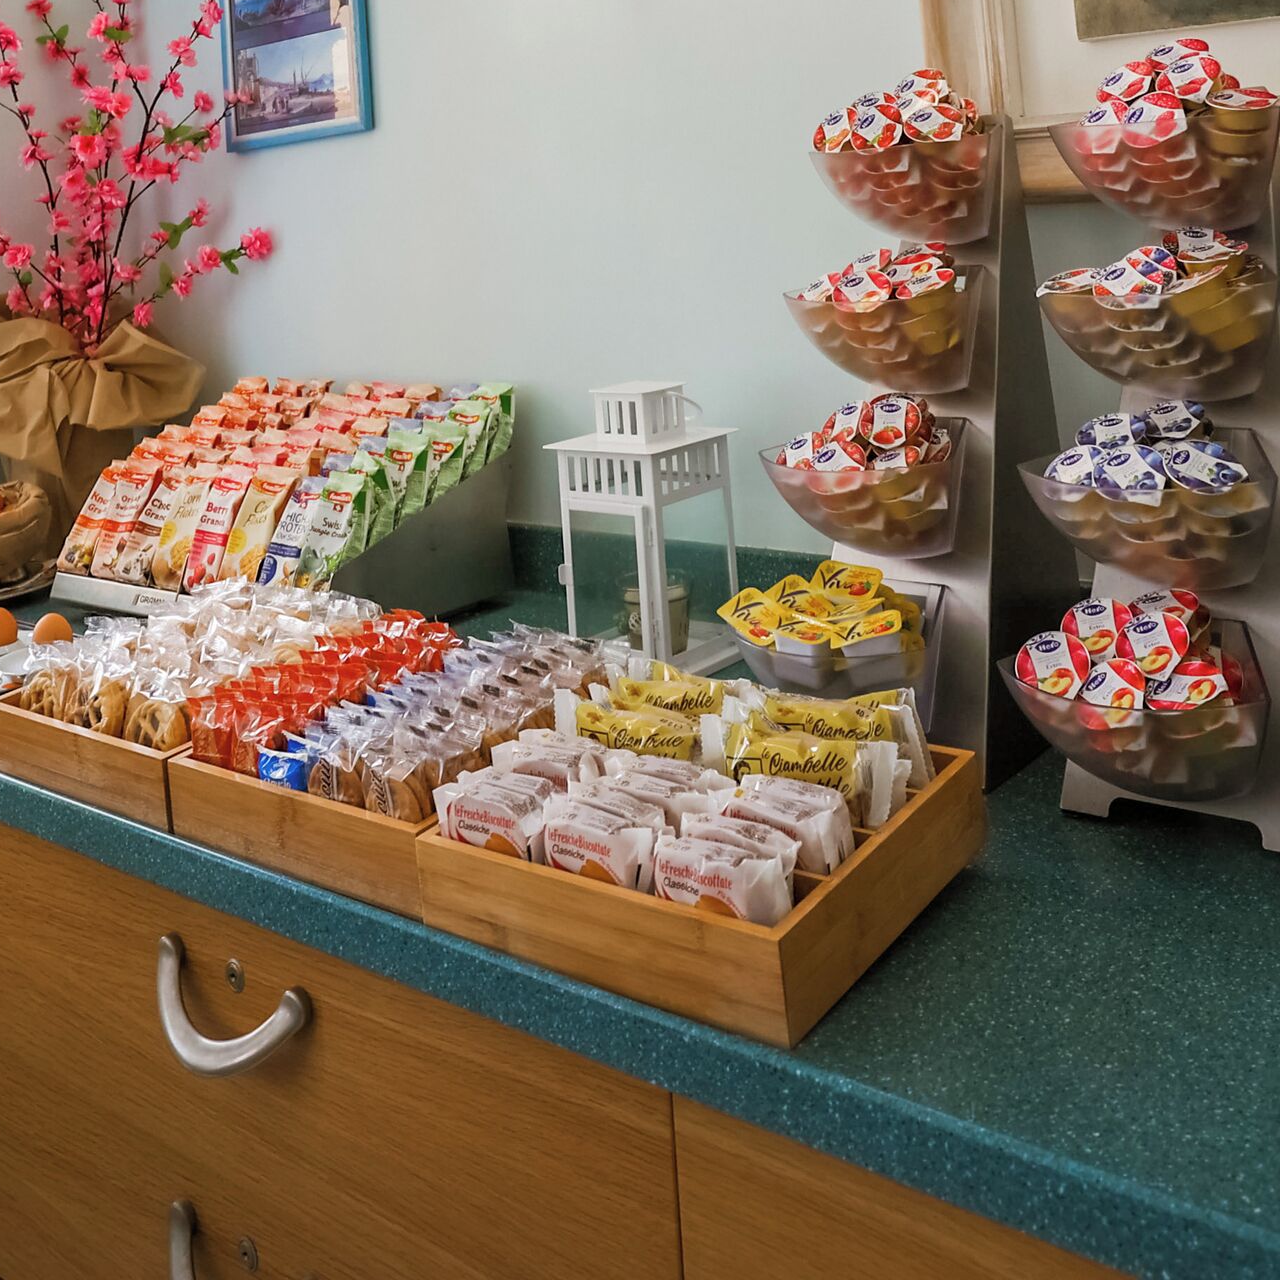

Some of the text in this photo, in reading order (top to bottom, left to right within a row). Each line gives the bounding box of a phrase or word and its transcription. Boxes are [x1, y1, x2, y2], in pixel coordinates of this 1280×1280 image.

[1083, 606, 1105, 615] Hero
[1135, 622, 1157, 633] Hero
[1037, 641, 1059, 653] Hero
[770, 752, 848, 776] Ciambelle
[551, 843, 586, 862] Classiche
[662, 875, 700, 897] Classiche
